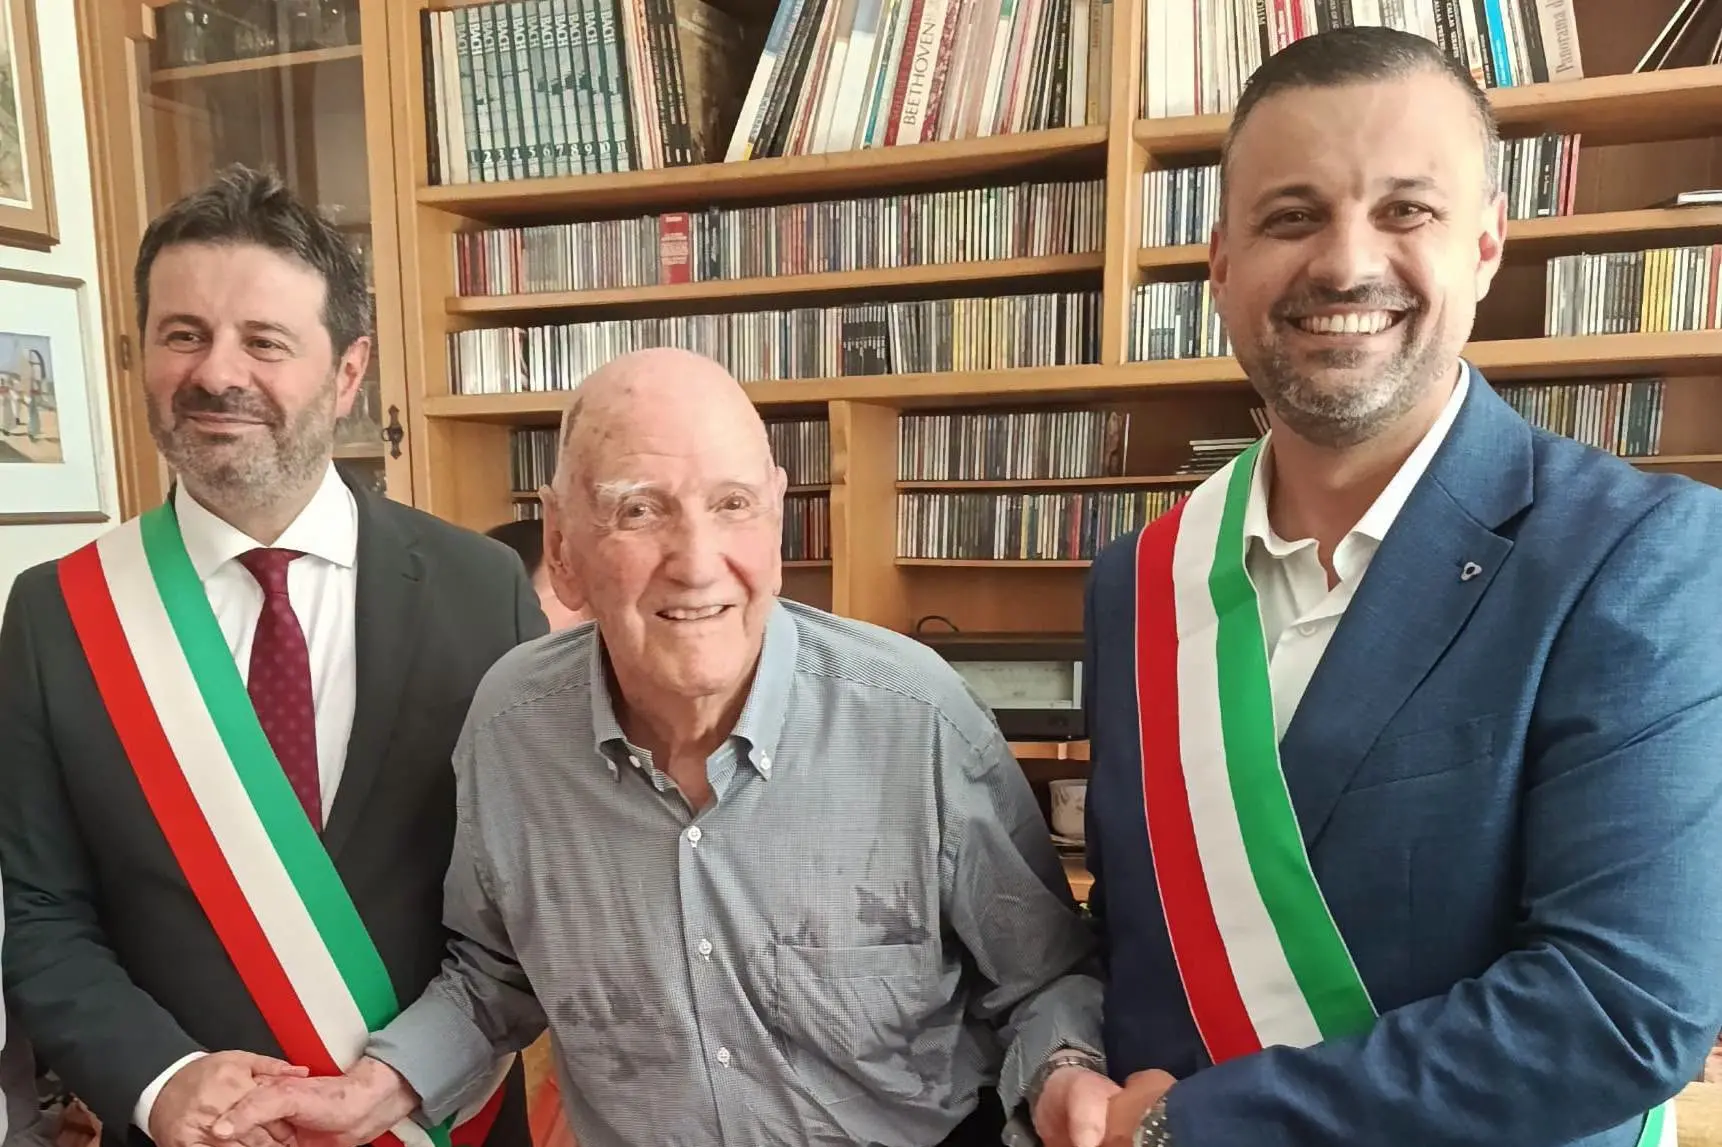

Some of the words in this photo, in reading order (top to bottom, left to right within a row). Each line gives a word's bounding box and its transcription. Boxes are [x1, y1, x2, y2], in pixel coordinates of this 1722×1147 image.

[456, 24, 468, 55] BACH
[469, 23, 482, 55] BACH
[482, 20, 495, 53] BACH
[497, 20, 510, 52] BACH
[513, 17, 526, 49] BACH
[526, 16, 540, 48] BACH
[540, 16, 554, 48] BACH
[555, 14, 568, 47] BACH
[569, 13, 581, 45] BACH
[584, 12, 598, 44] BACH
[601, 11, 615, 43] BACH
[1553, 10, 1573, 73] Panorama
[903, 22, 937, 125] BEETHOVEN
[471, 152, 478, 163] 1
[484, 151, 492, 162] 2
[498, 149, 505, 161] 3
[512, 148, 520, 160] 4
[529, 147, 536, 158] 5
[543, 145, 551, 156] 6
[556, 144, 564, 155] 7
[571, 143, 579, 155] 8
[584, 143, 592, 155] 9
[600, 142, 610, 154] 10
